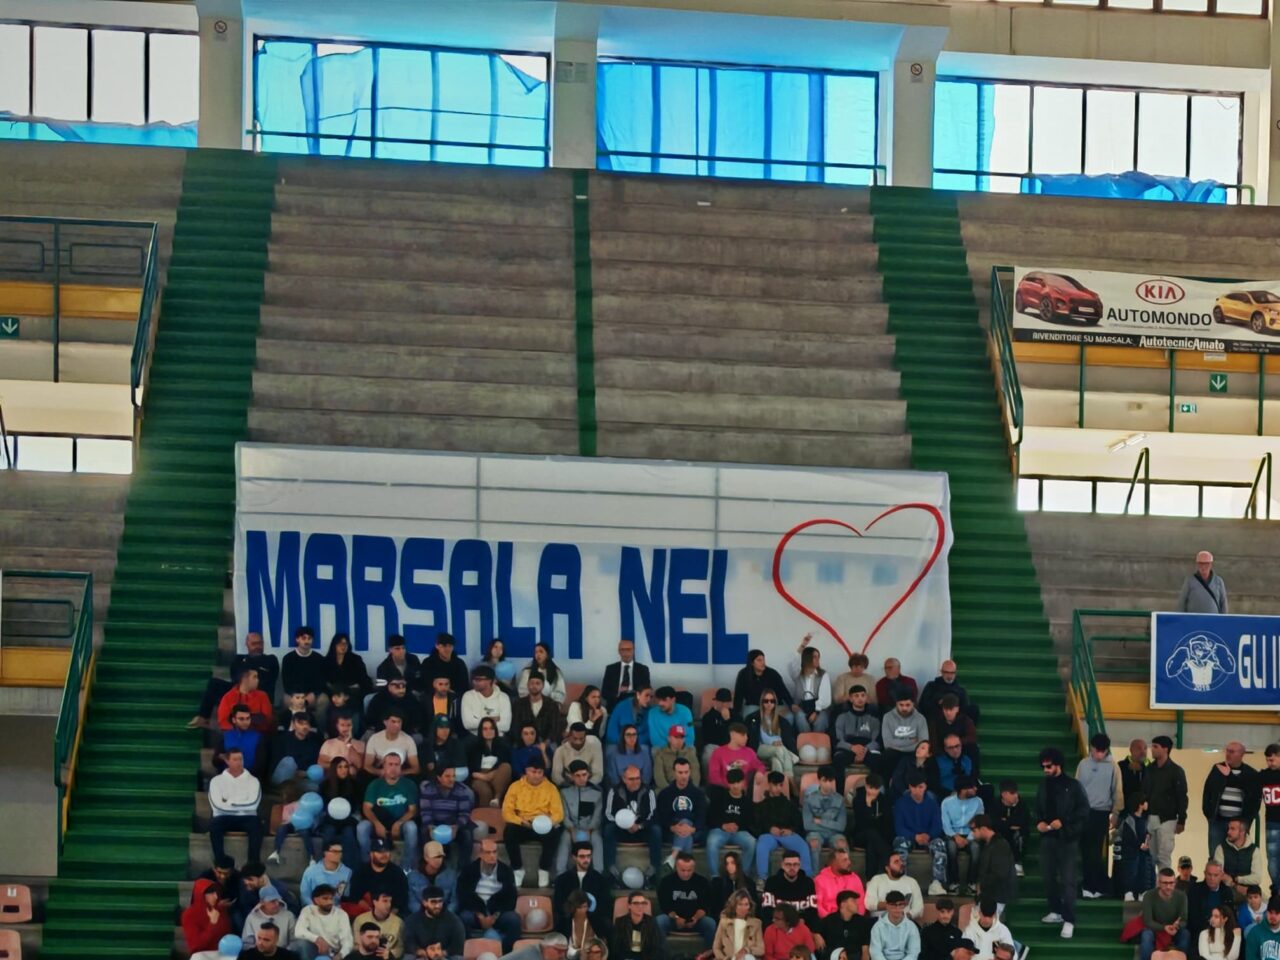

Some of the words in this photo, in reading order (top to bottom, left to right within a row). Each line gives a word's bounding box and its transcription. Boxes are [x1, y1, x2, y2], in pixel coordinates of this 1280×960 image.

[1144, 285, 1176, 300] KIA
[1107, 307, 1212, 326] AUTOMONDO
[1032, 332, 1081, 342] RIVENDITORE
[1084, 335, 1094, 343] SU
[1139, 335, 1225, 351] AutotecnicAmato
[246, 530, 583, 660] MARSALA
[619, 546, 749, 665] NEL
[1238, 634, 1267, 689] GLI
[672, 890, 698, 901] FILA
